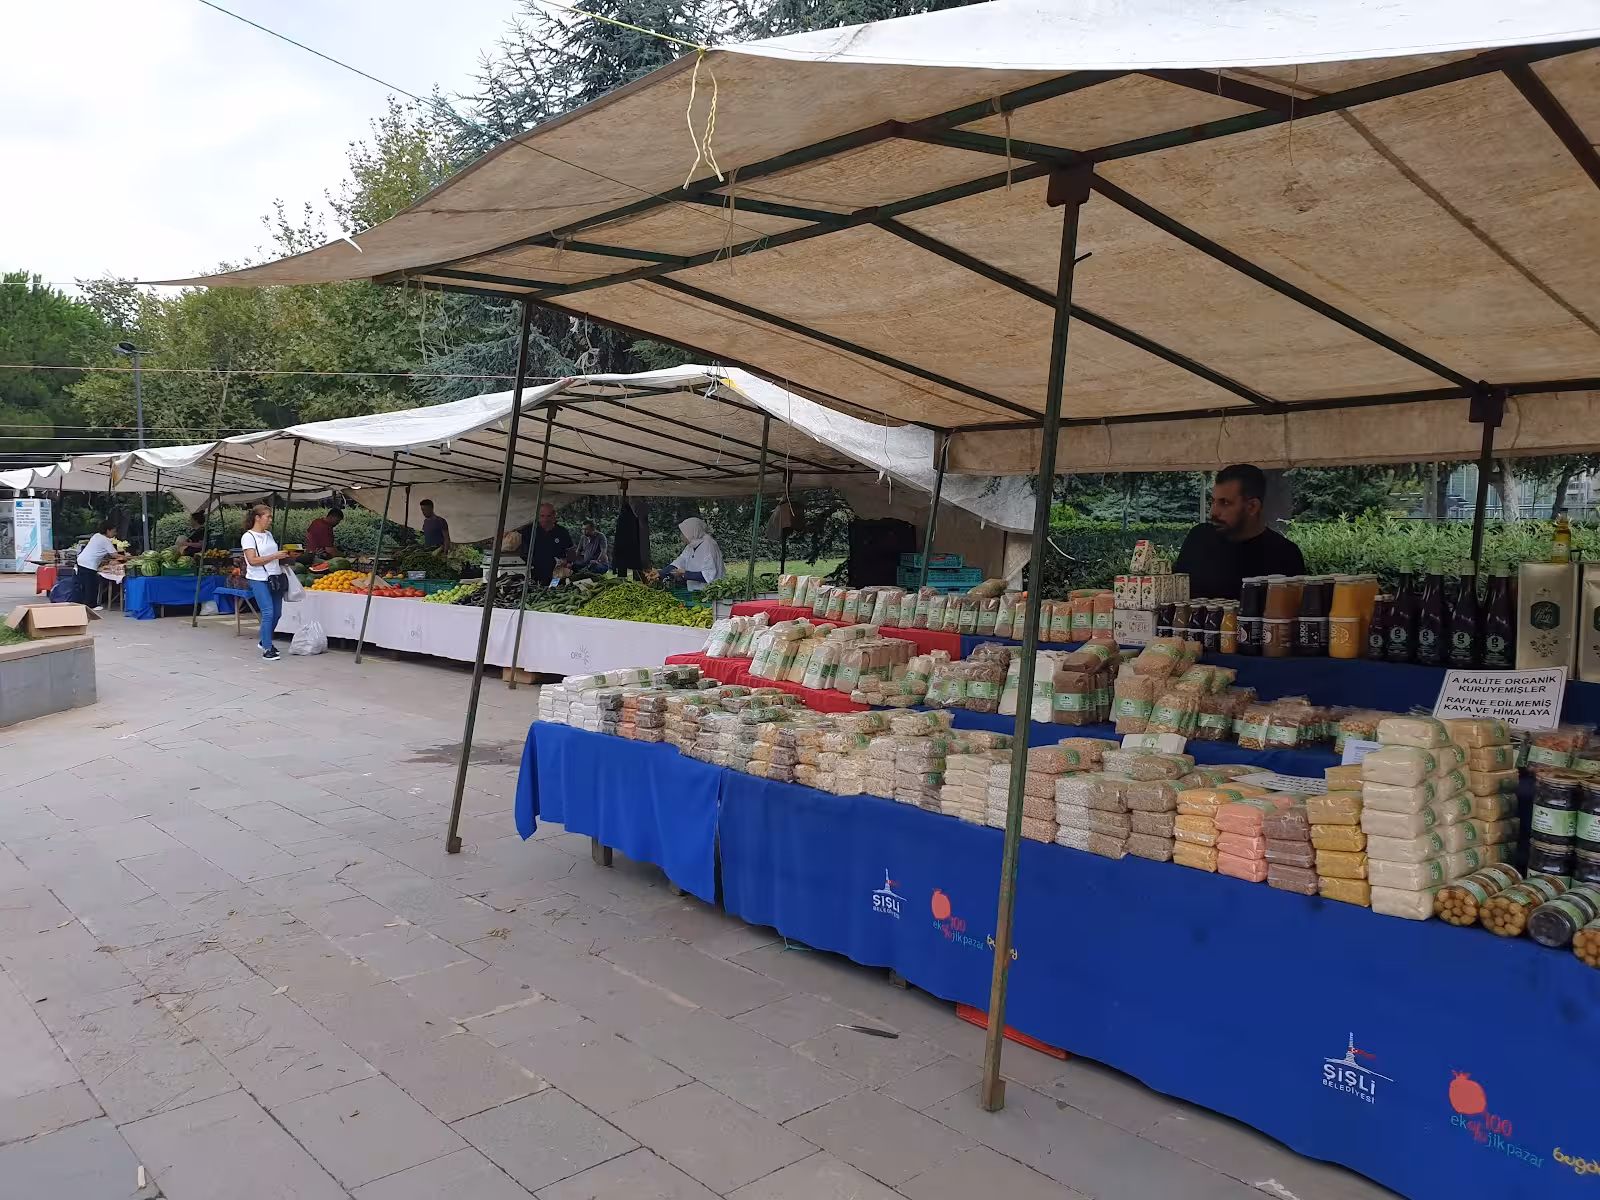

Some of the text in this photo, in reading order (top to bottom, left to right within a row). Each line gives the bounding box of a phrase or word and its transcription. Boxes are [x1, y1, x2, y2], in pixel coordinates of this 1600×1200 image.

[1462, 676, 1502, 685] KALİTE
[1505, 675, 1556, 685] ORGANİK
[1458, 685, 1546, 694] KURUYEMİŞLER
[1446, 696, 1552, 709] RAFİNE EDİLMEMİŞ
[1443, 704, 1551, 717] KAYA VE HİMALAYA
[963, 935, 985, 951] pazar
[1323, 1063, 1376, 1095] ŞİŞLİ
[1322, 1078, 1376, 1105] BELEDİYESİ
[1506, 1143, 1545, 1169] pazar
